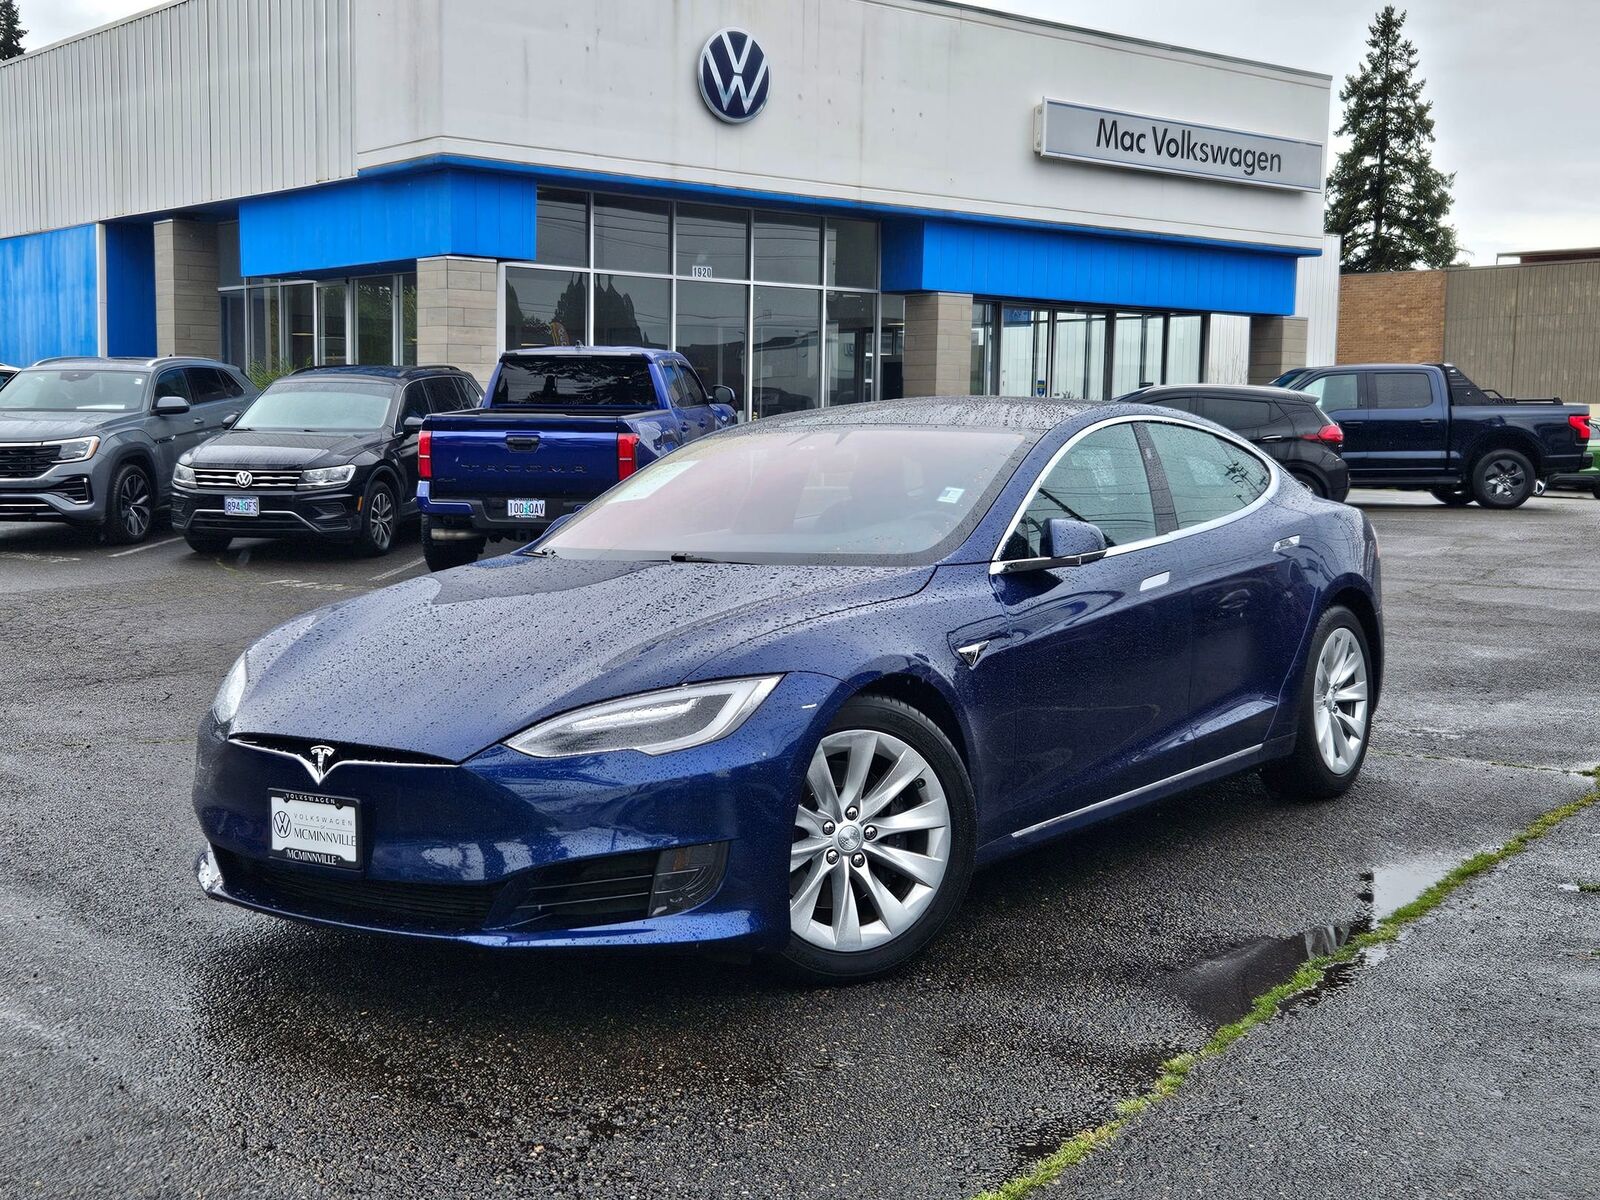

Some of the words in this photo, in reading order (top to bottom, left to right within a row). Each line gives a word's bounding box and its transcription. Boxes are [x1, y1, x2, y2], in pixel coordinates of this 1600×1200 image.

[700, 29, 770, 122] VW
[1096, 118, 1147, 154] Mac
[1152, 126, 1281, 175] Volkswagen
[694, 267, 712, 278] 1920
[510, 503, 524, 514] 100
[285, 793, 336, 804] VOLKSWAGEN
[294, 813, 353, 826] VOLKSWAGEN
[294, 828, 356, 847] MCMINNVILLE
[286, 849, 337, 865] MCMINNVILLE
